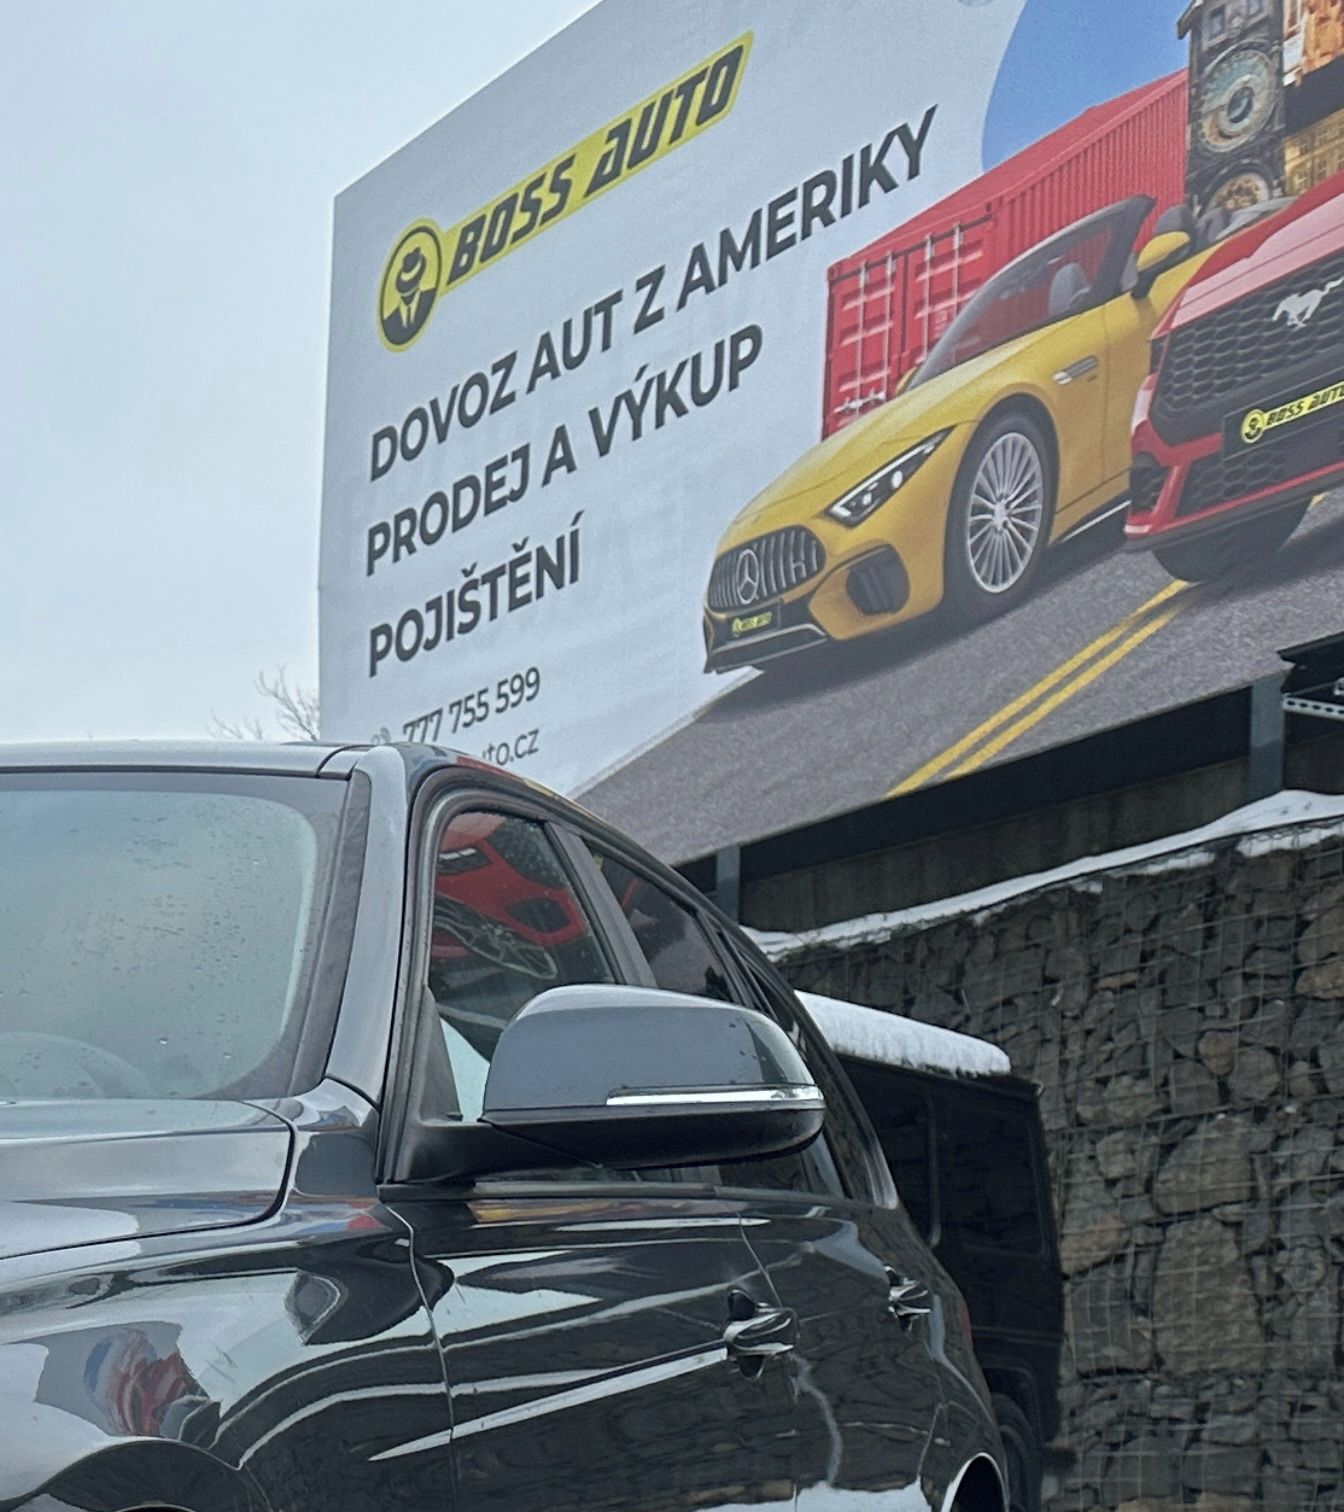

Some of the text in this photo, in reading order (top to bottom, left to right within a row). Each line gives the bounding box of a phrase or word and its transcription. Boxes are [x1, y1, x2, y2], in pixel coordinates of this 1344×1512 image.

[446, 43, 745, 287] BOSS AUTO
[370, 104, 939, 482] DOVOZ AUT Z AMERIKY
[366, 322, 764, 577] PRODEJ A VÝKUP
[369, 510, 586, 677] POJIŠTĚNÍ
[402, 666, 541, 744] 777 755 599
